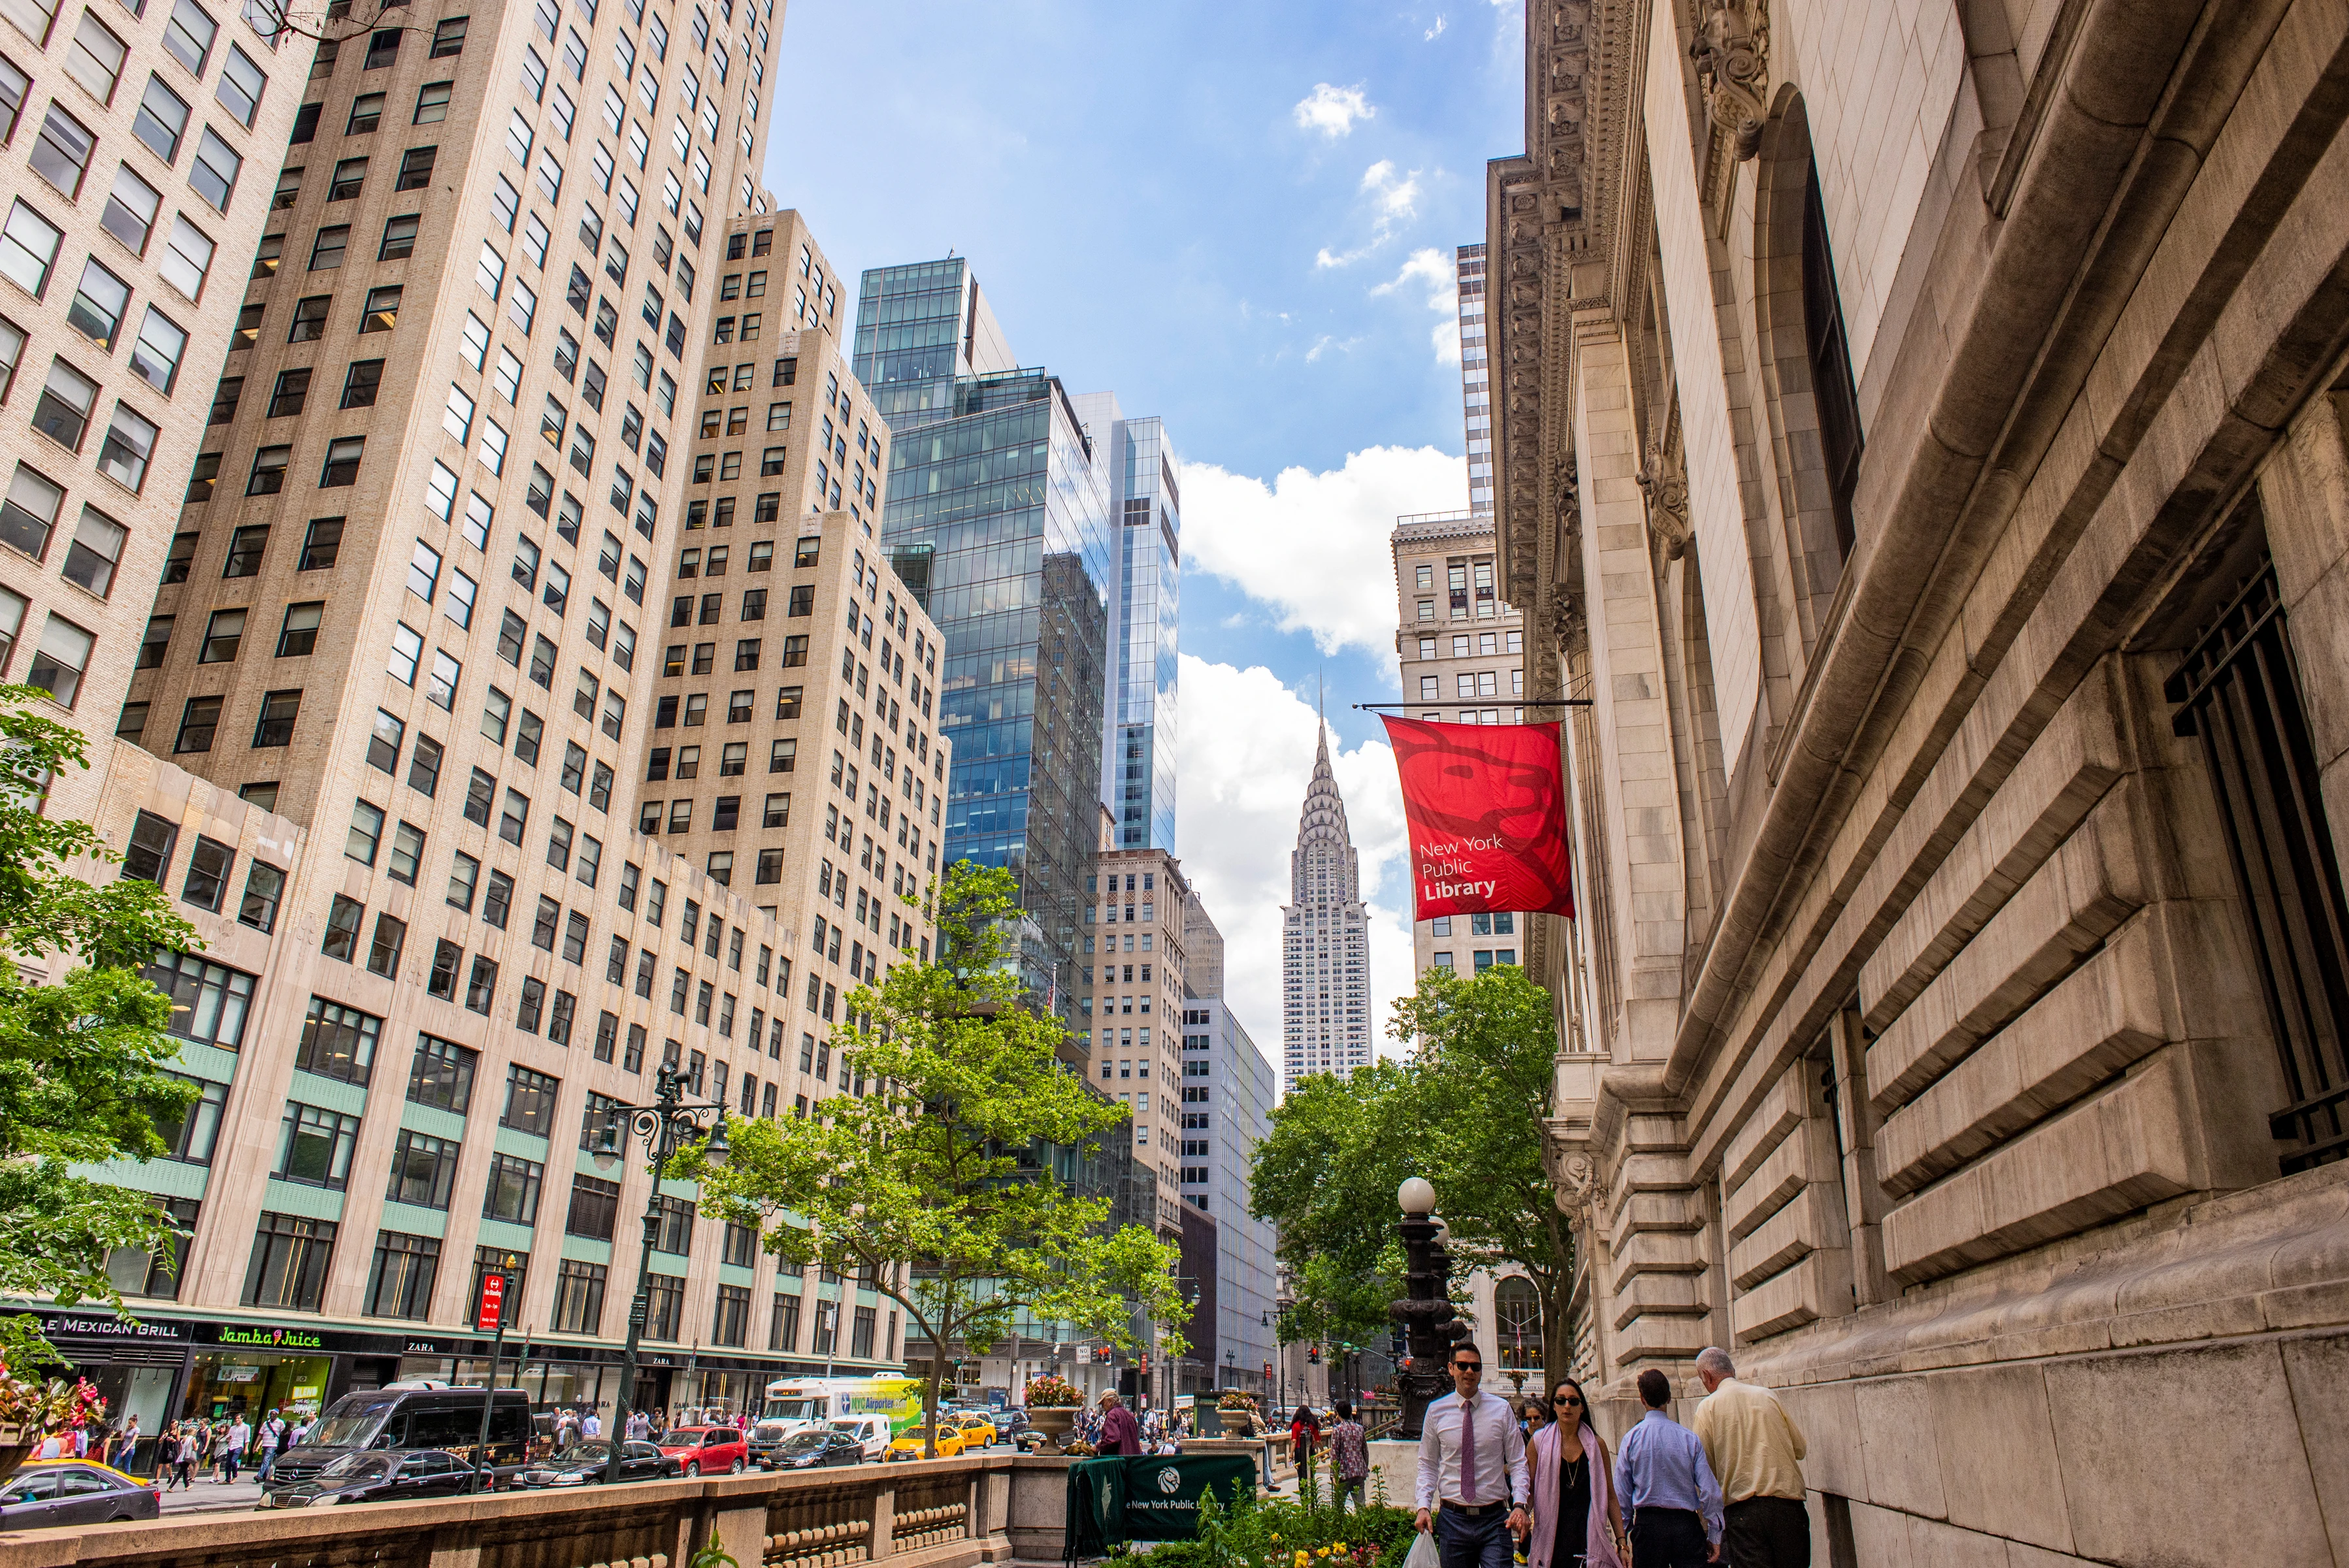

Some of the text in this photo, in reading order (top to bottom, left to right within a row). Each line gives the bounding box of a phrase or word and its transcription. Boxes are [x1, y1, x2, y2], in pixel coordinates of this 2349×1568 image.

[1420, 833, 1503, 858] New York
[1422, 858, 1473, 879] Public
[1424, 880, 1496, 901] Library
[63, 1318, 132, 1334] MEXICAN
[137, 1324, 178, 1337] GRILL
[219, 1326, 321, 1347] Jamba Juice
[408, 1343, 434, 1352] ZARA
[1132, 1500, 1149, 1509] New
[1151, 1499, 1168, 1509] York
[1170, 1500, 1194, 1509] Public
